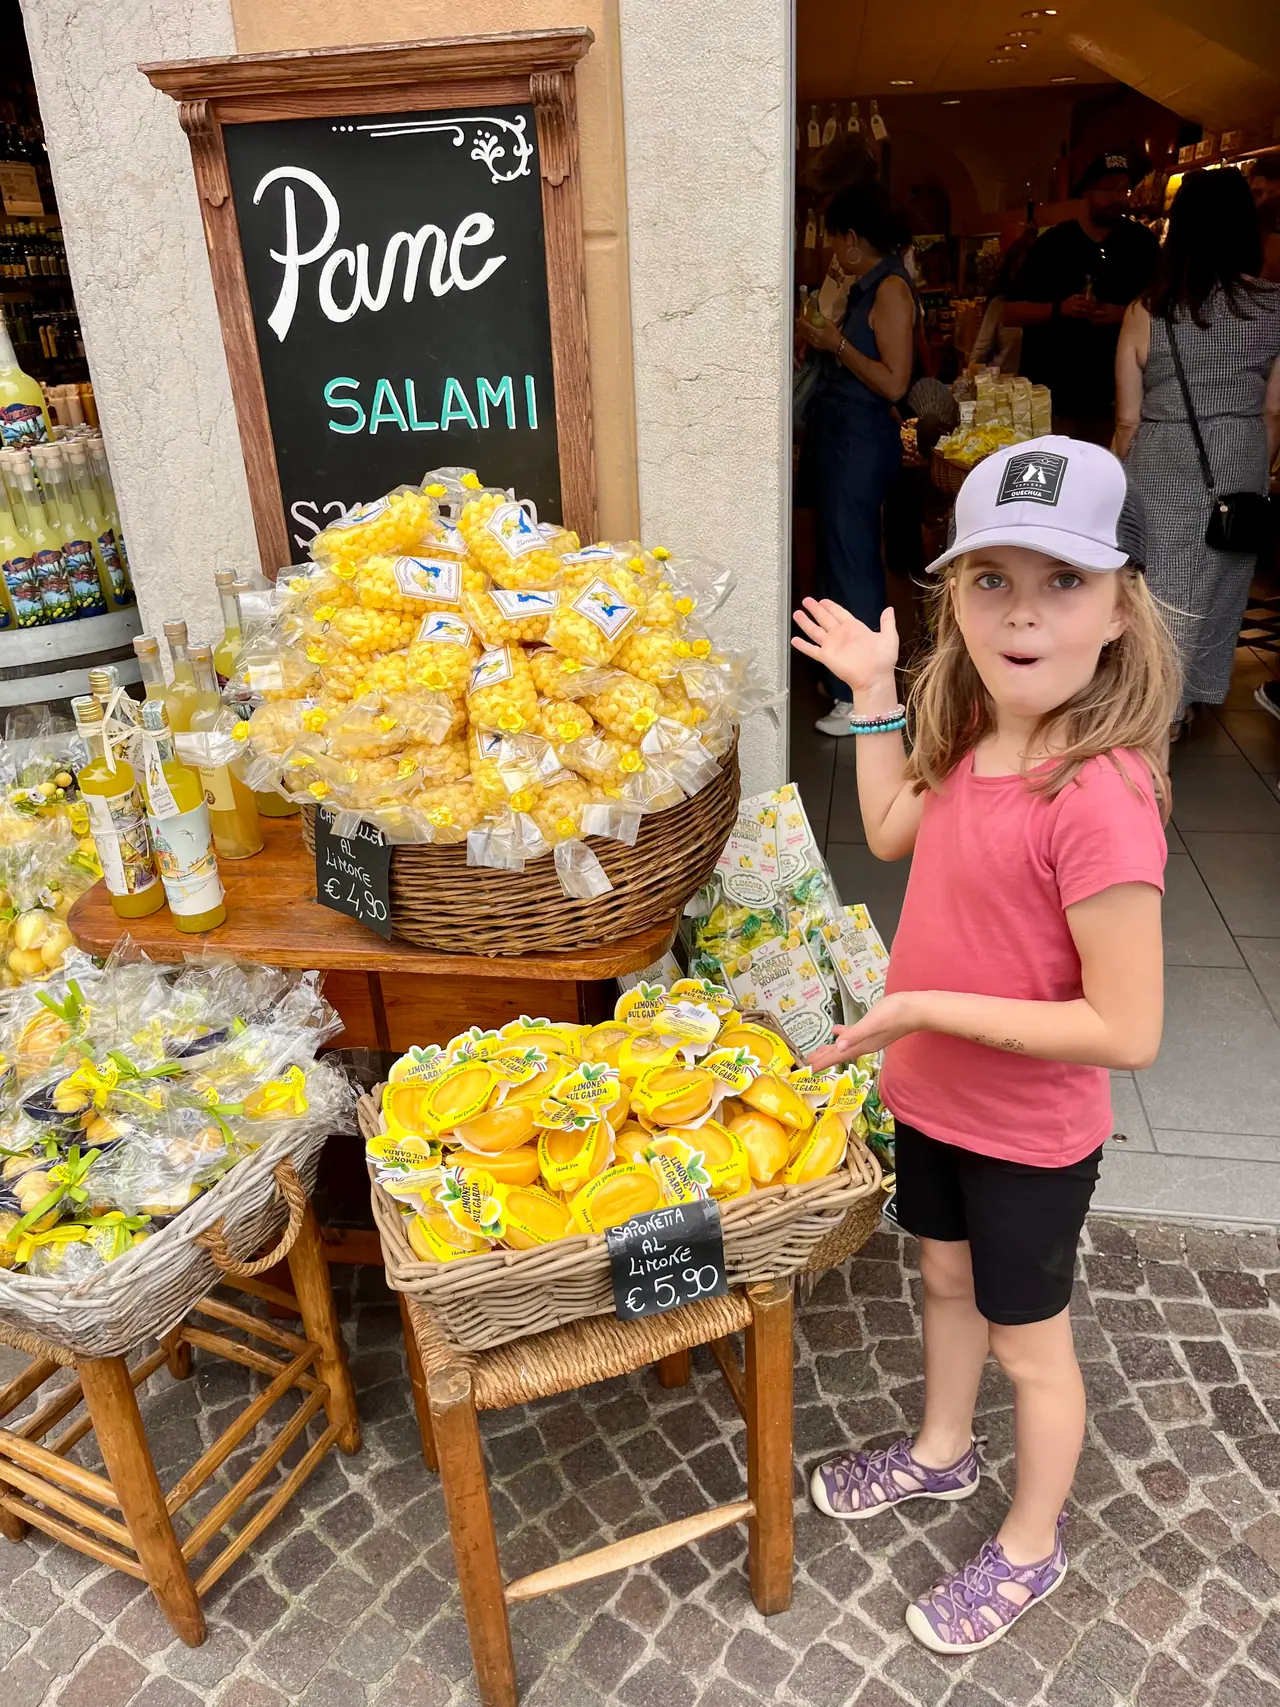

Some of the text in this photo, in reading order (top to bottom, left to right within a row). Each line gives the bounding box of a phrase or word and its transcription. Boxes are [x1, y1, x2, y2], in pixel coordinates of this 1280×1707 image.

[253, 165, 507, 343] Pane
[322, 374, 539, 436] SALAMI
[340, 838, 356, 859] AL
[323, 877, 387, 921] € 4,90
[750, 952, 790, 978] AMARETTI
[758, 967, 791, 989] MORBIDI
[684, 990, 721, 1004] SUL GARDA
[691, 988, 717, 999] LIMONE
[628, 1008, 660, 1019] SUL GAR
[634, 1000, 659, 1010] LIMONE
[786, 1017, 815, 1035] IMONE
[407, 1062, 436, 1076] LIMONE
[710, 1063, 739, 1083] SUL GARDA
[720, 1059, 742, 1075] LIMONE
[573, 1081, 602, 1092] LIMONE
[581, 1088, 608, 1100] GARDA
[383, 1148, 428, 1161] SUL GARDA
[658, 1154, 670, 1171] SUL
[665, 1169, 686, 1201] GARDA
[670, 1156, 692, 1189] LIMONE
[461, 1184, 472, 1214] LIMONE
[472, 1182, 481, 1224] SUL GARDA
[611, 1207, 685, 1241] SAPONETTA
[641, 1236, 667, 1255] AL
[624, 1264, 719, 1312] € 5,90
